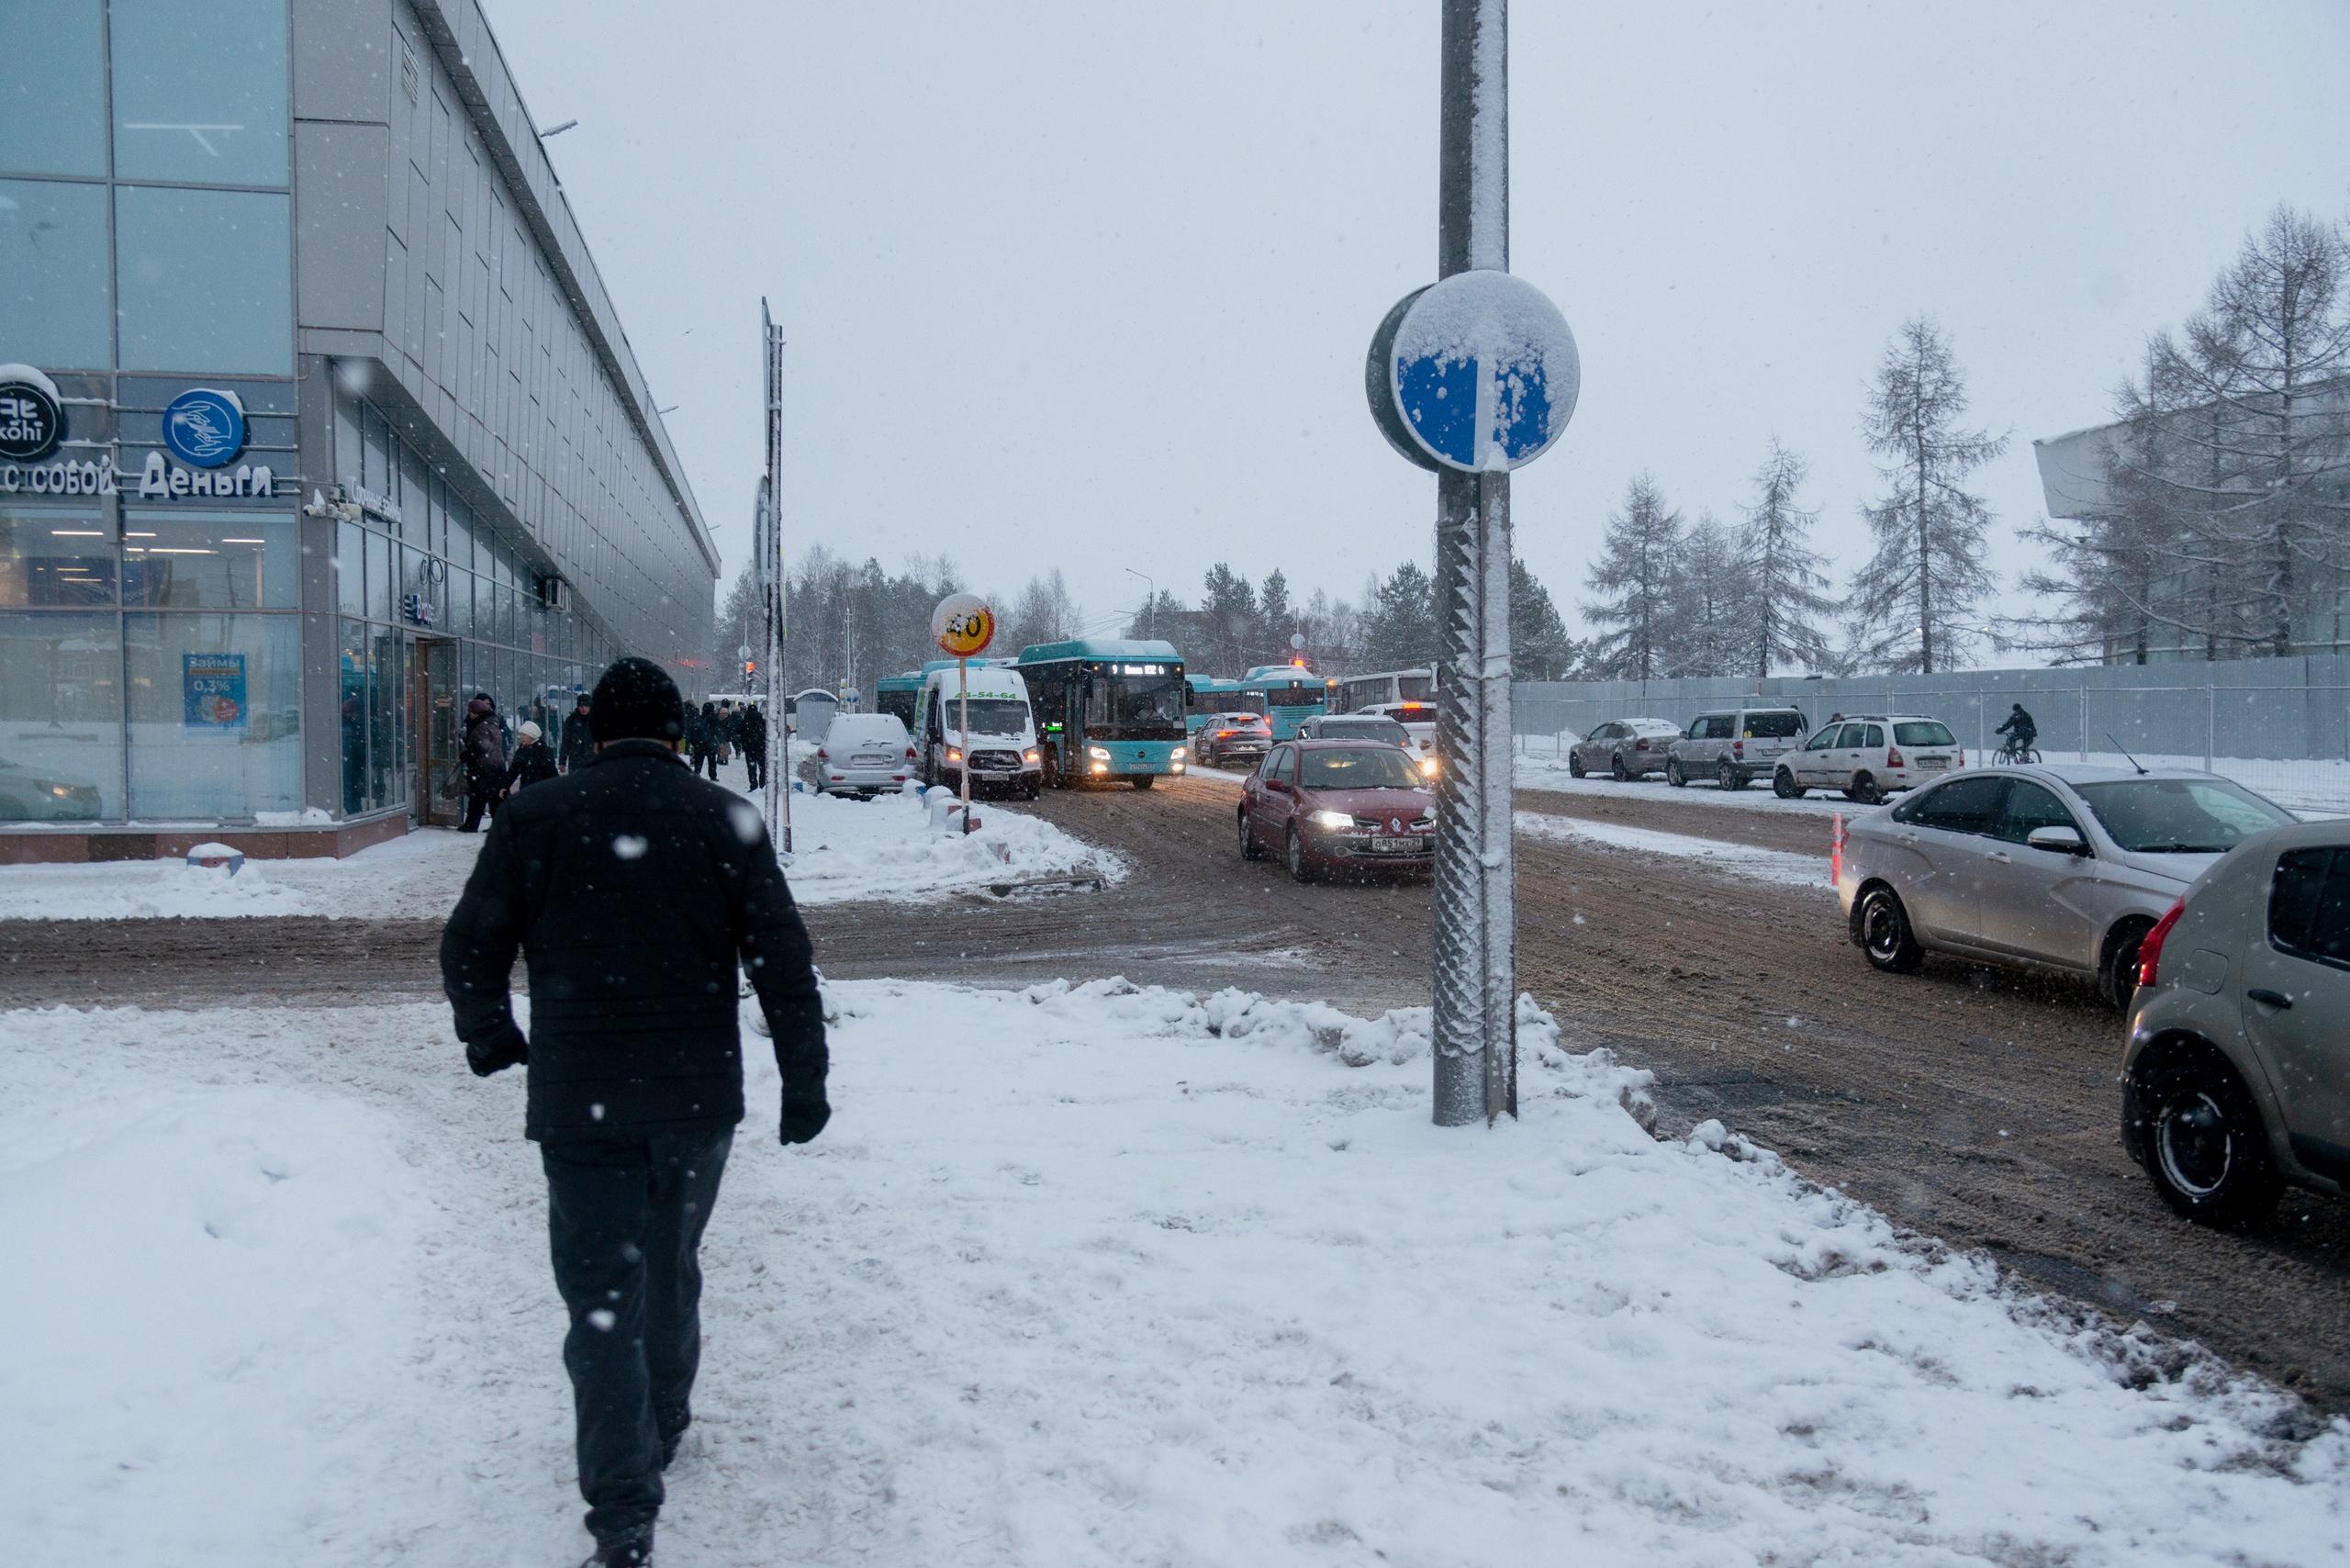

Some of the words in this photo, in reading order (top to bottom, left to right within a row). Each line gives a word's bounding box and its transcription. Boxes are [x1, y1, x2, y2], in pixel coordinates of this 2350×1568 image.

[139, 456, 273, 498] Деньги
[189, 656, 241, 668] Займы
[1112, 664, 1118, 675] 9
[194, 679, 230, 693] 0,3%
